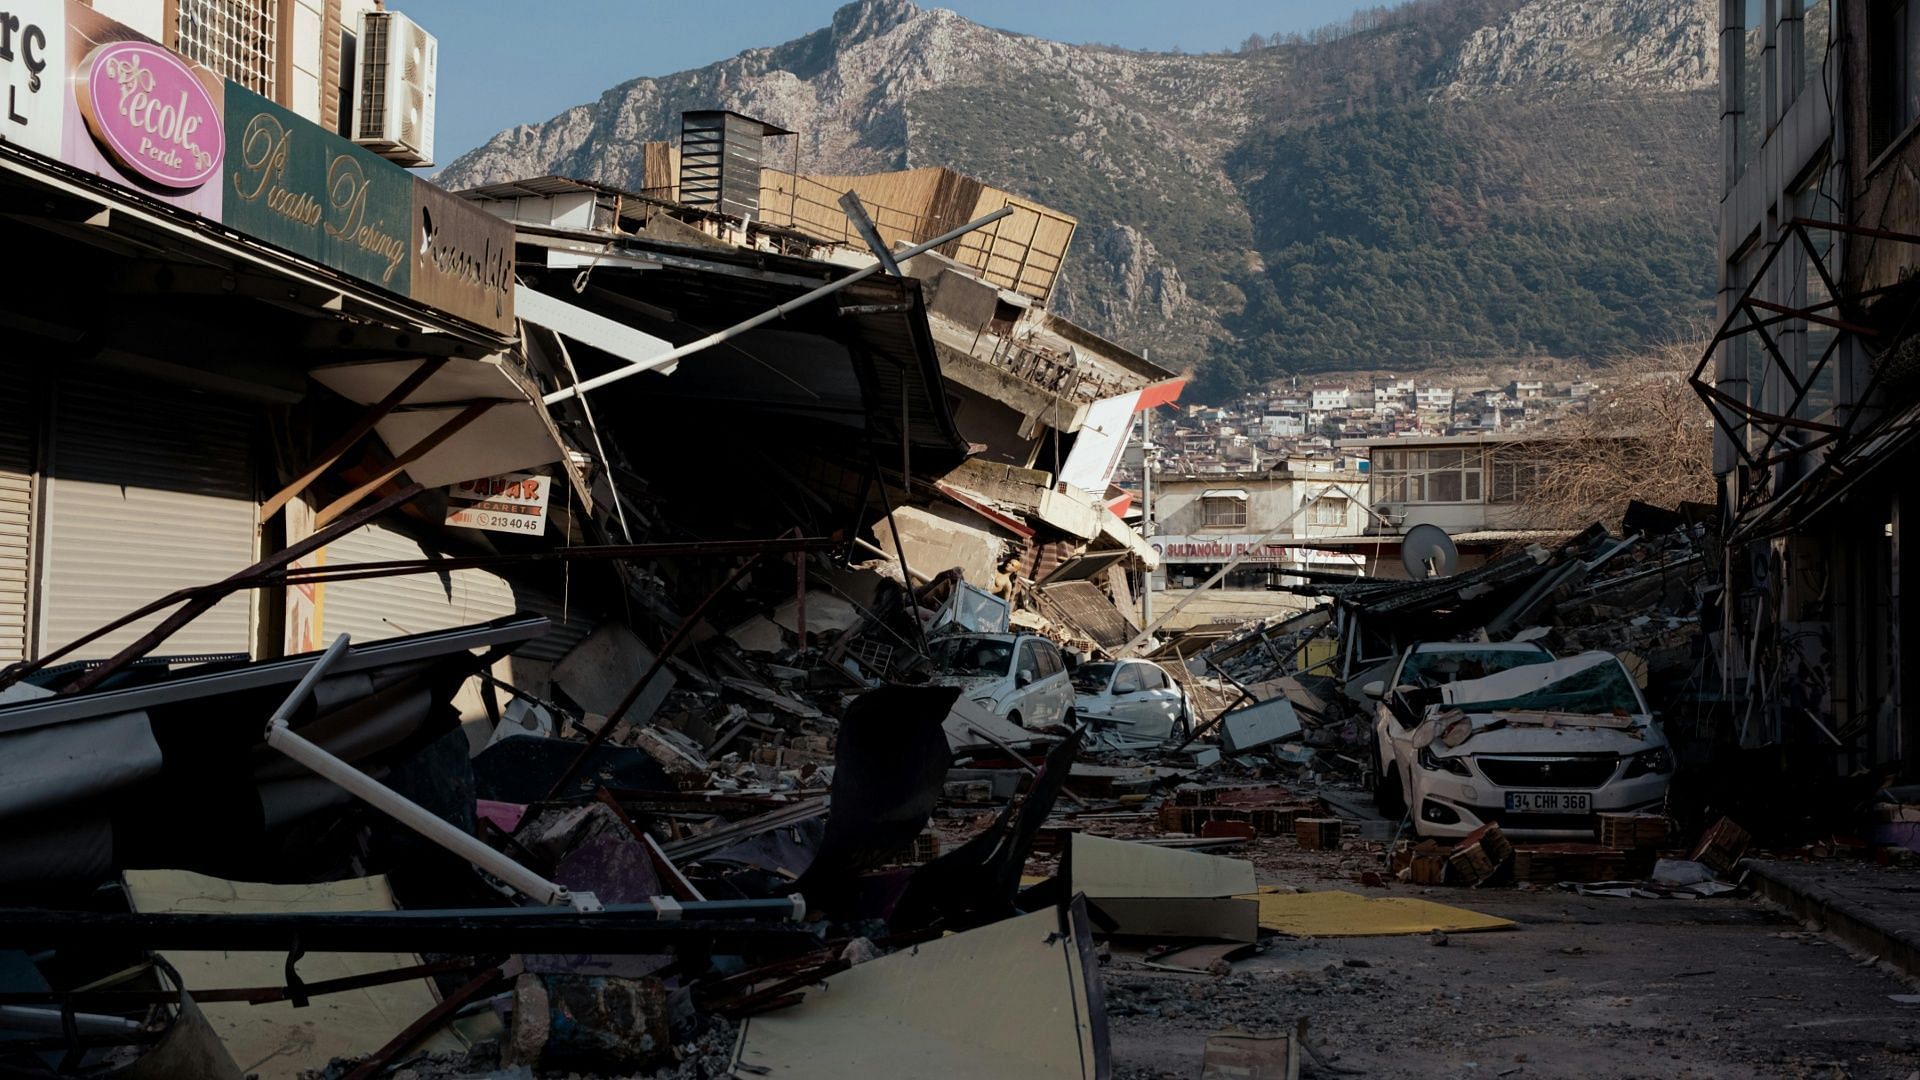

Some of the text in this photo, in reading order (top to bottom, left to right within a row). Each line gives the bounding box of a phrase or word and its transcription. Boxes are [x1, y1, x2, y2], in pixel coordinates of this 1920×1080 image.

[139, 136, 182, 169] Perde
[234, 113, 323, 229] Picasso
[491, 516, 537, 531] 213 40 45
[1167, 540, 1232, 557] SULTANOĞLU
[1514, 794, 1586, 809] 34 CHH 368
